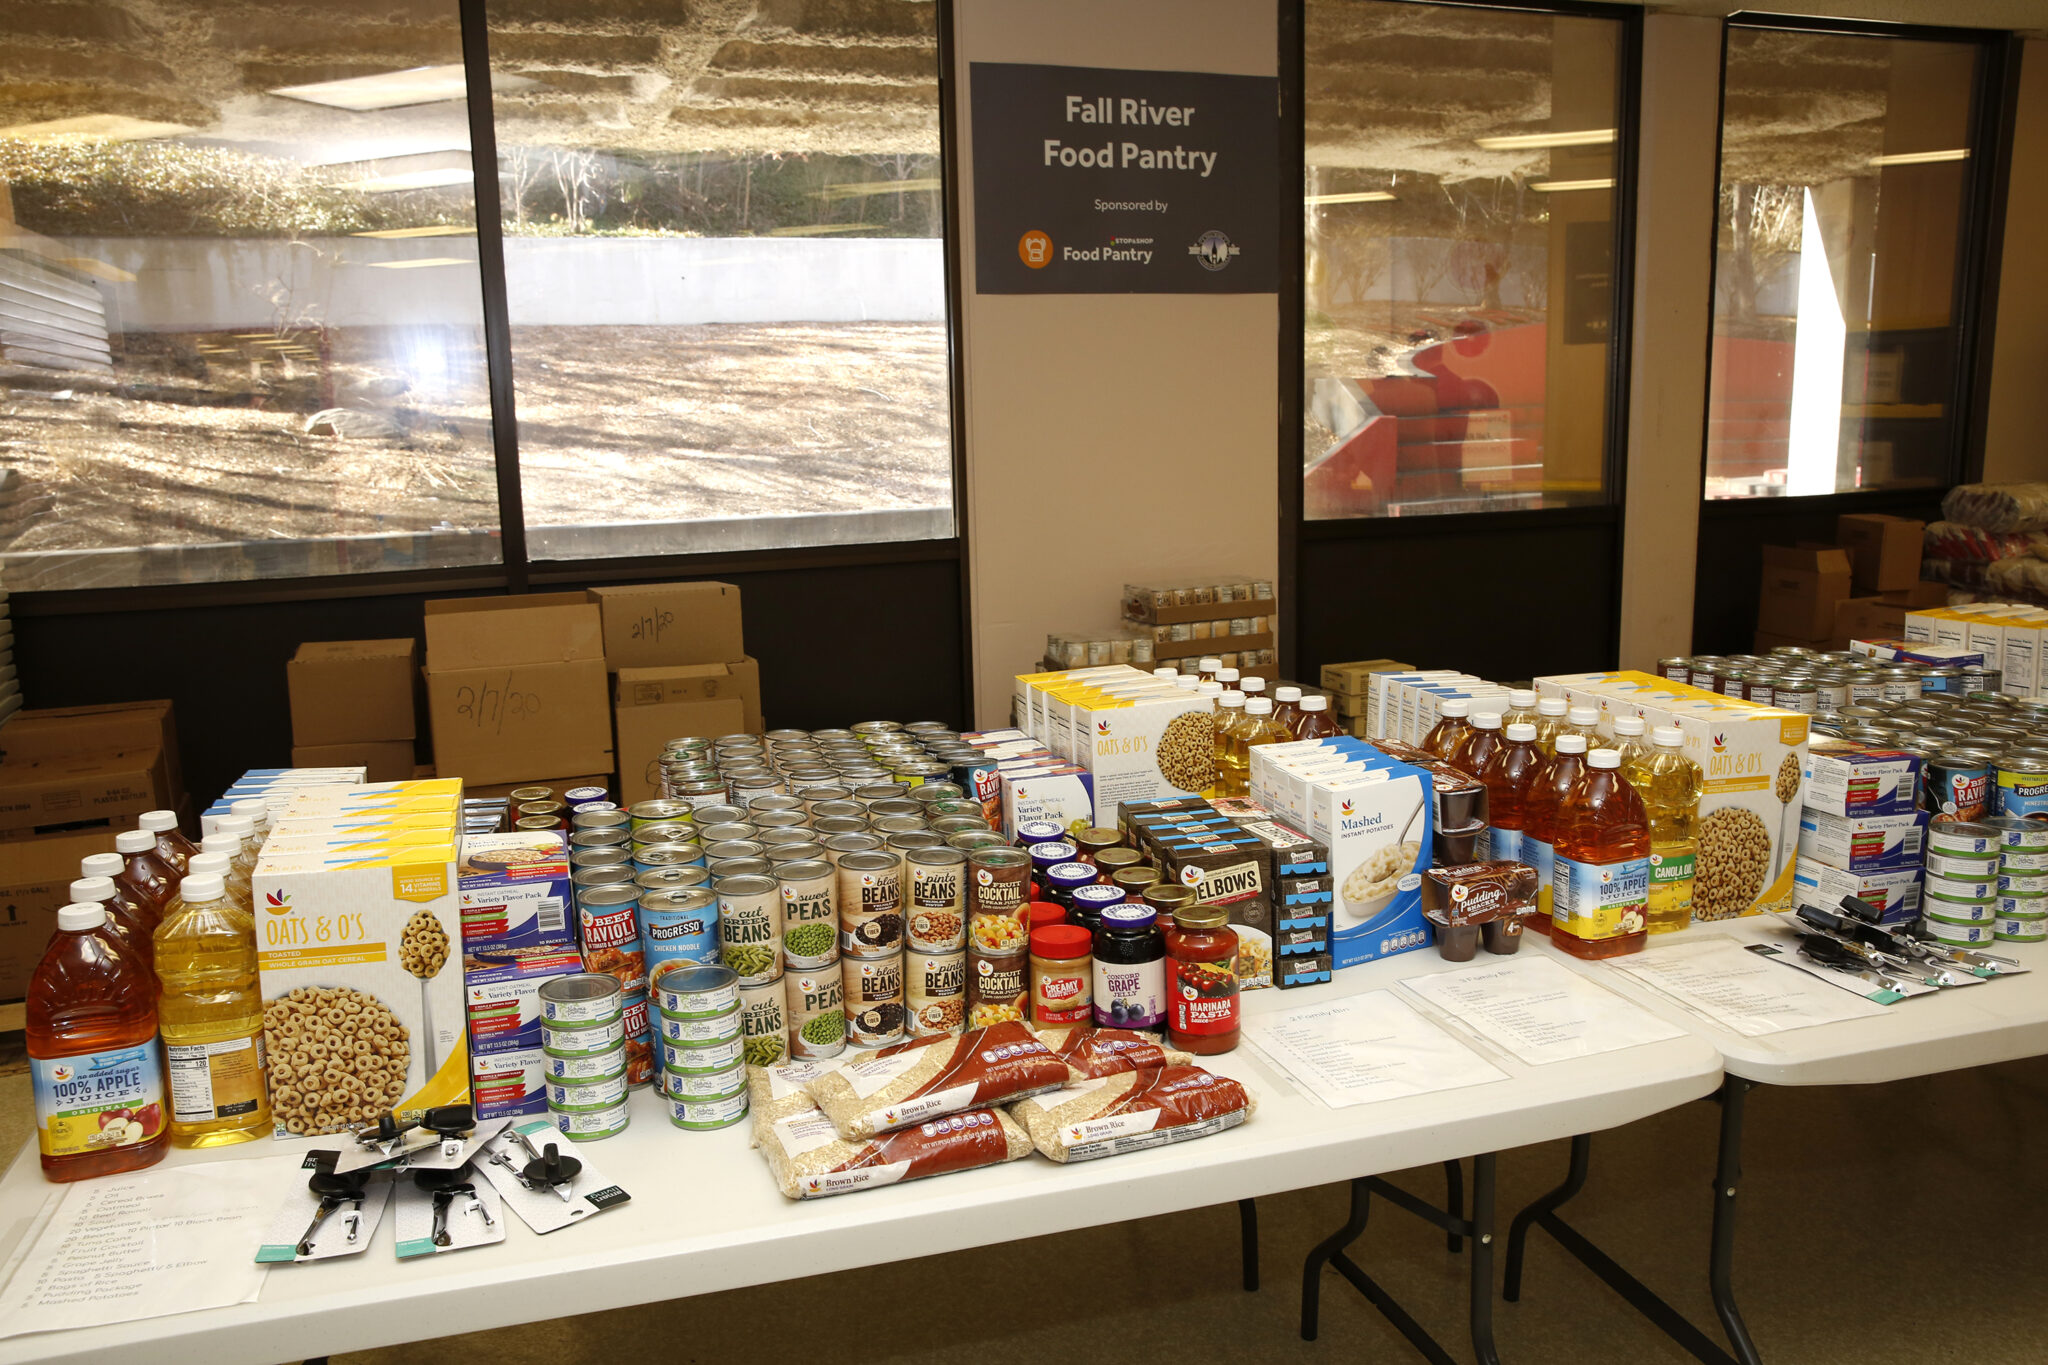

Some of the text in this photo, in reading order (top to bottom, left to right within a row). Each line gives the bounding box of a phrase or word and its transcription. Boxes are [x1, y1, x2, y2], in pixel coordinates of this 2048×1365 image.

[1066, 96, 1195, 126] Fall River
[1044, 140, 1217, 177] Food Pantry
[1095, 199, 1168, 213] Sponsored by
[1064, 247, 1152, 264] Food Pantry
[631, 607, 674, 642] 2/7/20
[457, 670, 541, 734] 2/7/20
[1098, 736, 1148, 756] OATS & O'S
[1710, 752, 1762, 776] OATS & O'S
[2018, 785, 2048, 796] PROGRE
[1018, 805, 1043, 814] Variety
[1019, 814, 1042, 822] Flavor
[1341, 813, 1382, 830] Mashed
[1341, 824, 1394, 839] INSTANT POTATOES
[926, 873, 956, 883] pinto
[1655, 865, 1693, 878] CANOLA OIL
[400, 884, 413, 894] 14
[914, 882, 956, 898] BEANS
[1197, 871, 1256, 899] ELBOWS
[1600, 877, 1646, 895] 100% APPLE
[477, 896, 500, 904] Variety
[502, 894, 524, 902] Flavor
[798, 889, 829, 902] sweet
[862, 883, 899, 903] BEANS
[978, 886, 1021, 900] COCKTAIL
[1606, 890, 1640, 900] JUICE
[1461, 889, 1501, 912] pudding
[739, 906, 762, 918] cut
[786, 899, 831, 920] PEAS
[594, 911, 632, 926] BEEF
[723, 916, 769, 926] GREEN
[266, 913, 365, 945] OATS & O'S
[586, 921, 635, 943] RAVIOLI
[652, 921, 700, 939] PROGRESSO
[724, 923, 771, 943] BEANS
[1508, 922, 1514, 932] 4
[612, 939, 624, 947] MEAT
[939, 961, 964, 973] pinto
[862, 973, 900, 993] BEANS
[925, 970, 964, 988] BEANS
[979, 975, 1021, 990] COCKTAIL
[1108, 978, 1140, 992] GRAPE
[488, 988, 536, 999] Variety Flavor
[1046, 980, 1078, 993] CREAMY
[751, 997, 774, 1010] cut
[805, 985, 843, 1011] PEAS
[623, 1002, 646, 1018] EEF
[1190, 1000, 1231, 1012] MARINARA
[1191, 1009, 1231, 1018] PASTA
[494, 1059, 541, 1069] Variety Flavor
[89, 1070, 113, 1078] added
[116, 1066, 139, 1074] sugar
[53, 1072, 140, 1098] 100% APPLE
[66, 1090, 130, 1104] JUICE
[72, 1104, 128, 1115] ORIGINAL
[901, 1099, 942, 1116] Brown Rice
[1086, 1121, 1125, 1133] Brown Rice
[826, 1173, 869, 1187] Brown Rice
